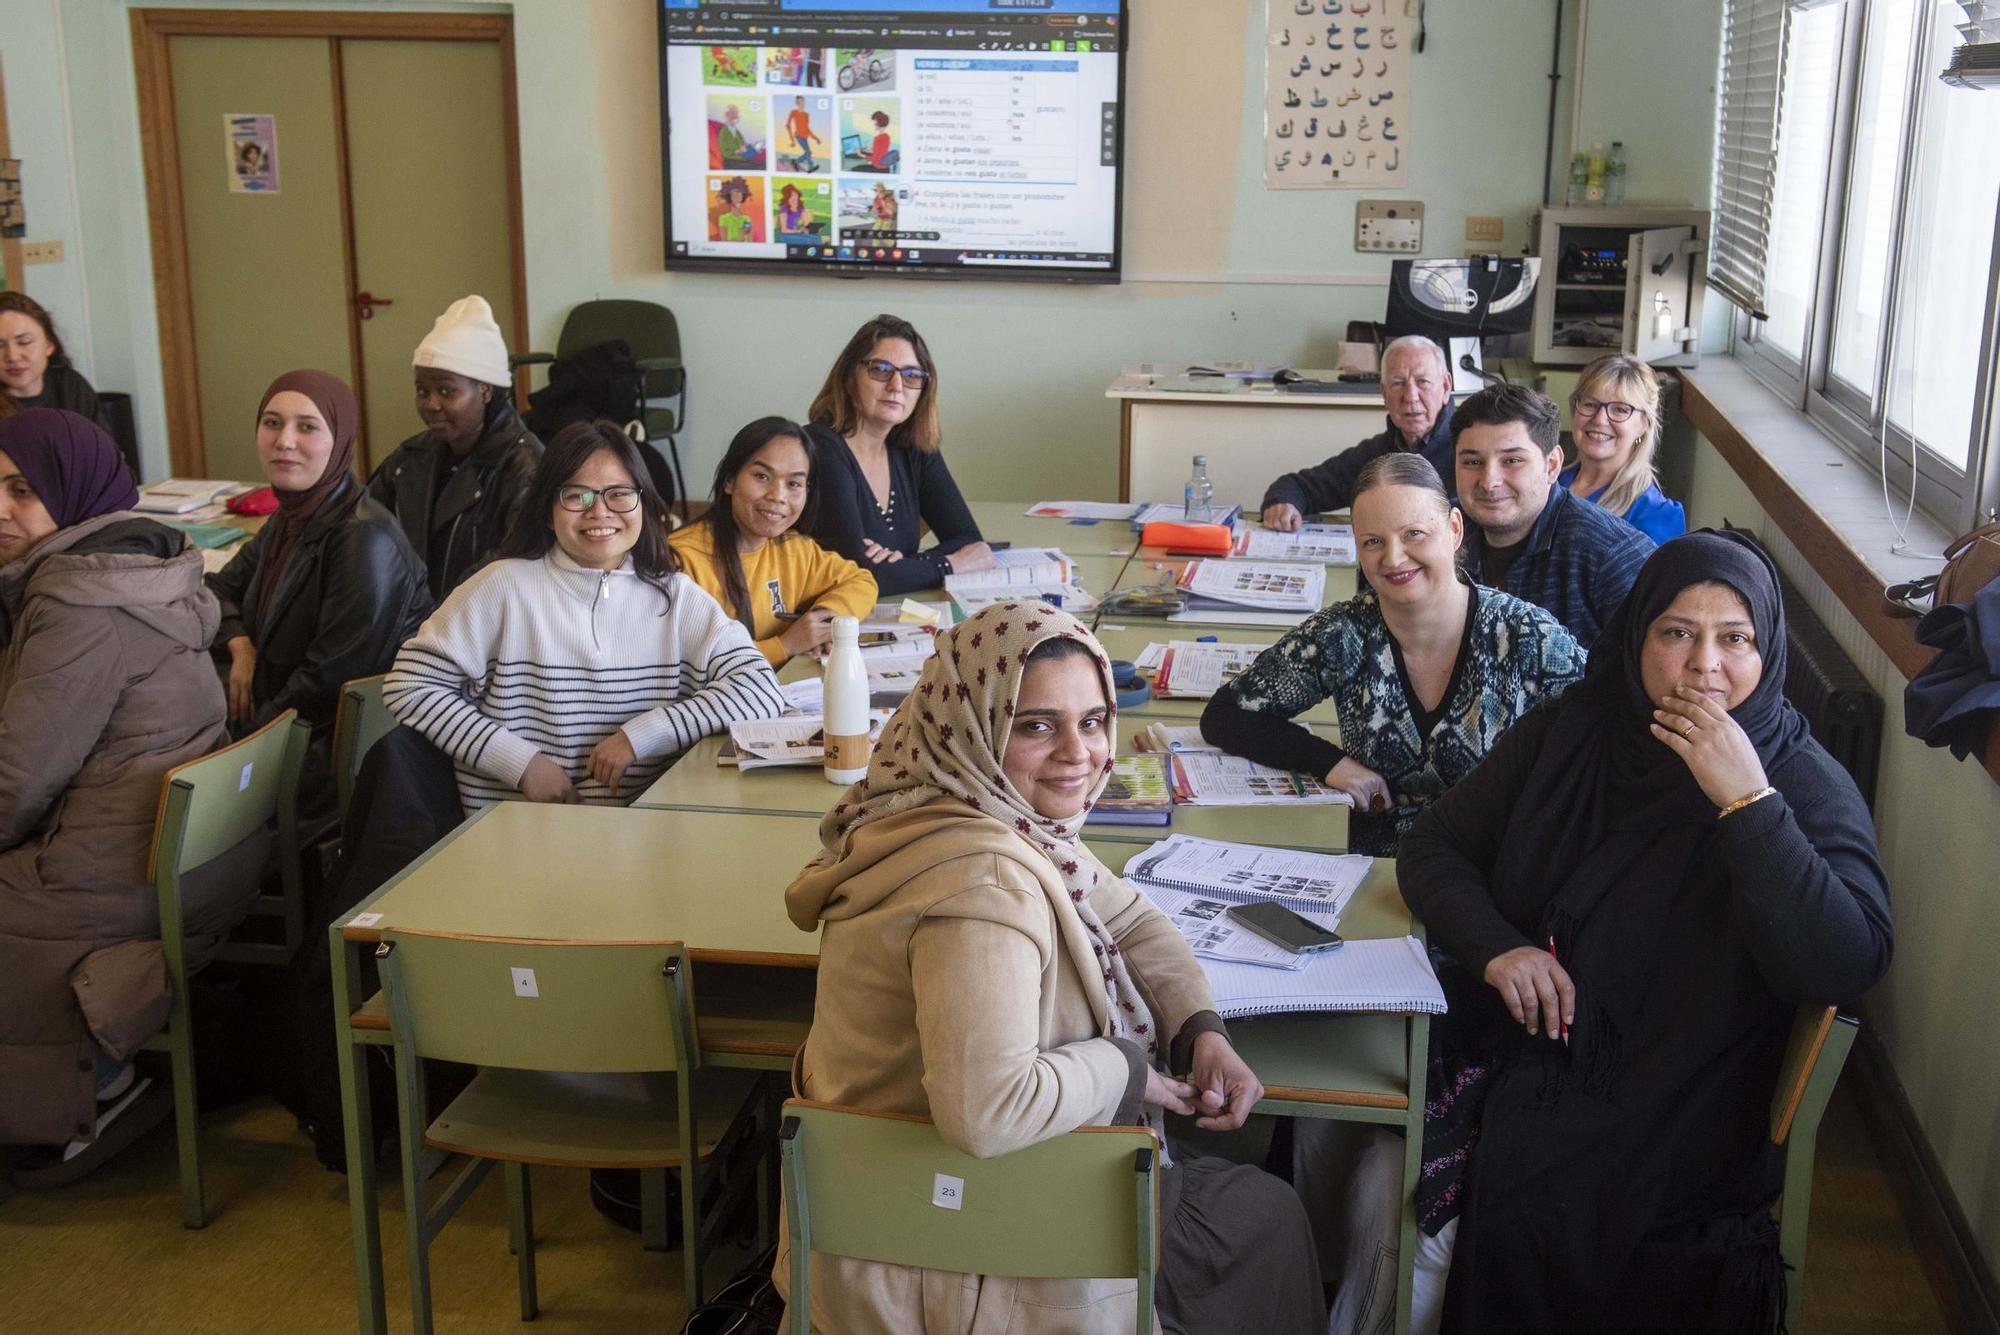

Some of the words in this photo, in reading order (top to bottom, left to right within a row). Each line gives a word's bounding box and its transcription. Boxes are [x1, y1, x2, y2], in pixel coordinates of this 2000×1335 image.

[1326, 22, 1344, 50] خ
[1353, 26, 1371, 50] ح
[1380, 26, 1398, 49] ج
[1290, 55, 1311, 78] ش
[1320, 60, 1341, 77] س
[1375, 60, 1388, 78] ر
[1283, 88, 1302, 108] ظ
[1310, 88, 1328, 108] ط
[1276, 119, 1294, 138] ك
[1304, 118, 1318, 138] ق
[1327, 120, 1346, 138] ف
[1358, 115, 1373, 141] غ
[1382, 117, 1398, 140] ع
[1275, 150, 1291, 171] ي
[1342, 151, 1355, 166] ن
[1385, 147, 1399, 171] ل
[942, 1187, 956, 1197] 23
